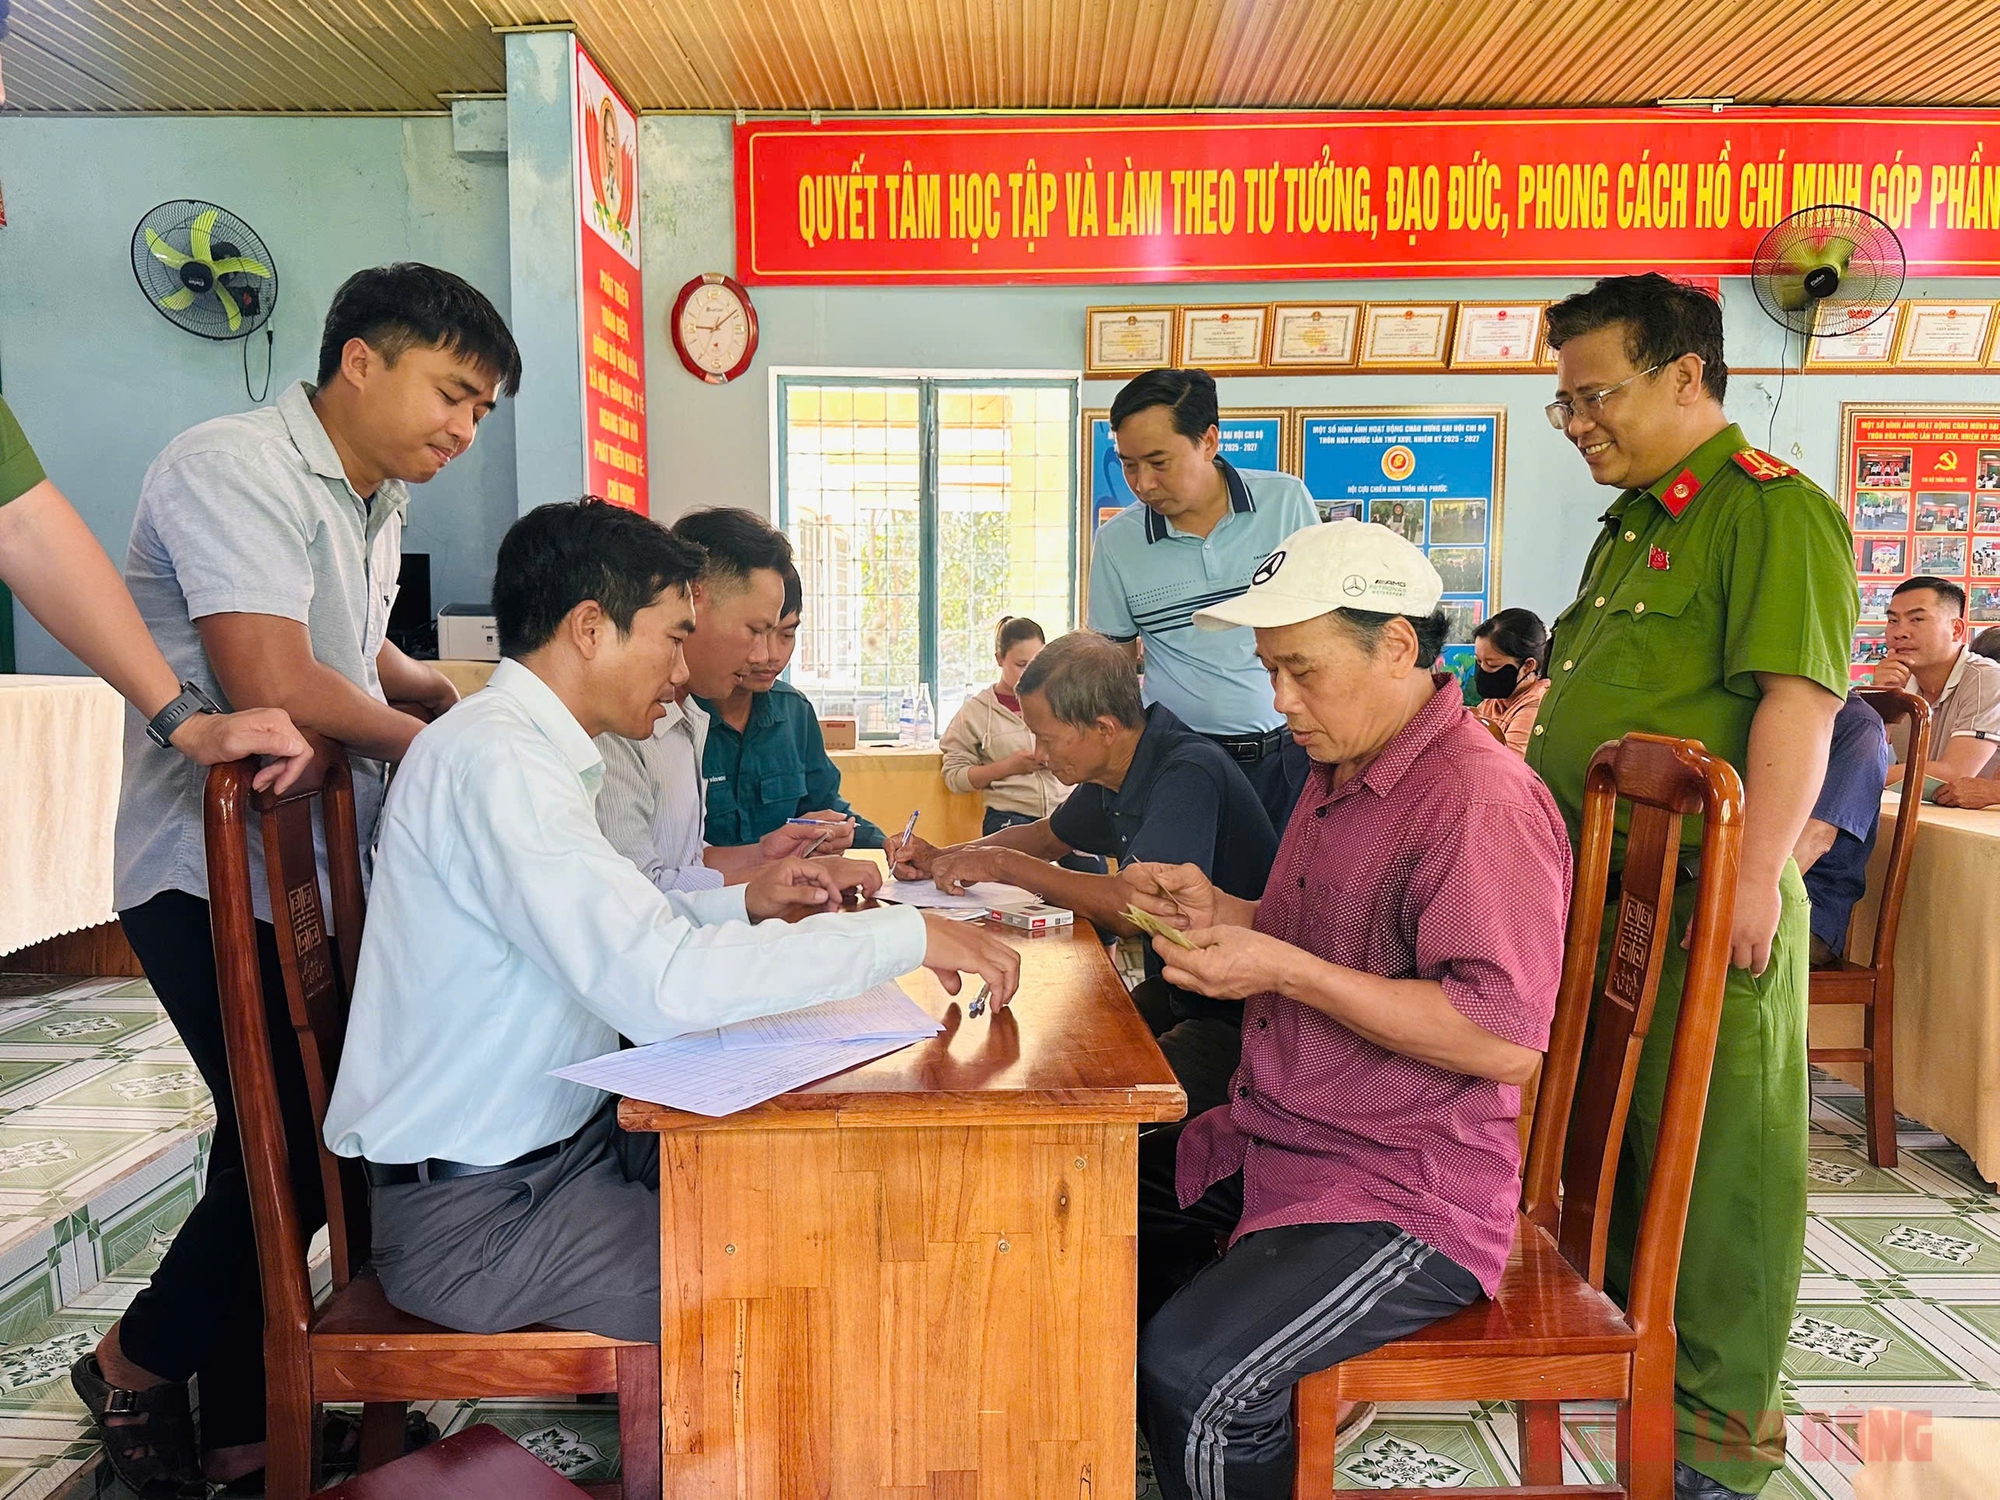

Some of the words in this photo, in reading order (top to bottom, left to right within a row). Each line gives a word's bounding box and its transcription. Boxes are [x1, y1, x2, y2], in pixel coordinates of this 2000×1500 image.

[800, 153, 877, 247] QUYẾT
[886, 160, 940, 240] TÂM
[950, 173, 1000, 253] HỌC
[1009, 158, 1057, 253] TẬP
[1066, 157, 1098, 238] VÀ
[1107, 156, 1162, 237] LÀM
[1171, 168, 1235, 236] THEO
[1244, 162, 1279, 234] TƯ
[1284, 144, 1377, 240] TƯỞNG,
[1387, 164, 1439, 246] ĐẠO
[1447, 151, 1508, 239] ĐỨC,
[1518, 163, 1608, 230] PHONG
[1617, 149, 1688, 230] CÁCH
[1696, 140, 1731, 229] HỒ
[1739, 149, 1786, 228] CHÍ
[1791, 163, 1862, 228] MINH
[1869, 150, 1923, 229] GÓP
[1930, 142, 2000, 231] PHẦN
[1313, 425, 1326, 434] MỘT
[1327, 424, 1337, 434] SỐ
[1338, 424, 1353, 433] HÌNH
[1354, 424, 1367, 433] ẢNH
[1368, 425, 1385, 434] HOẠT
[1386, 424, 1404, 434] ĐỘNG
[1465, 424, 1477, 433] CHI
[1477, 423, 1487, 433] BỘ
[1443, 435, 1460, 443] 2025
